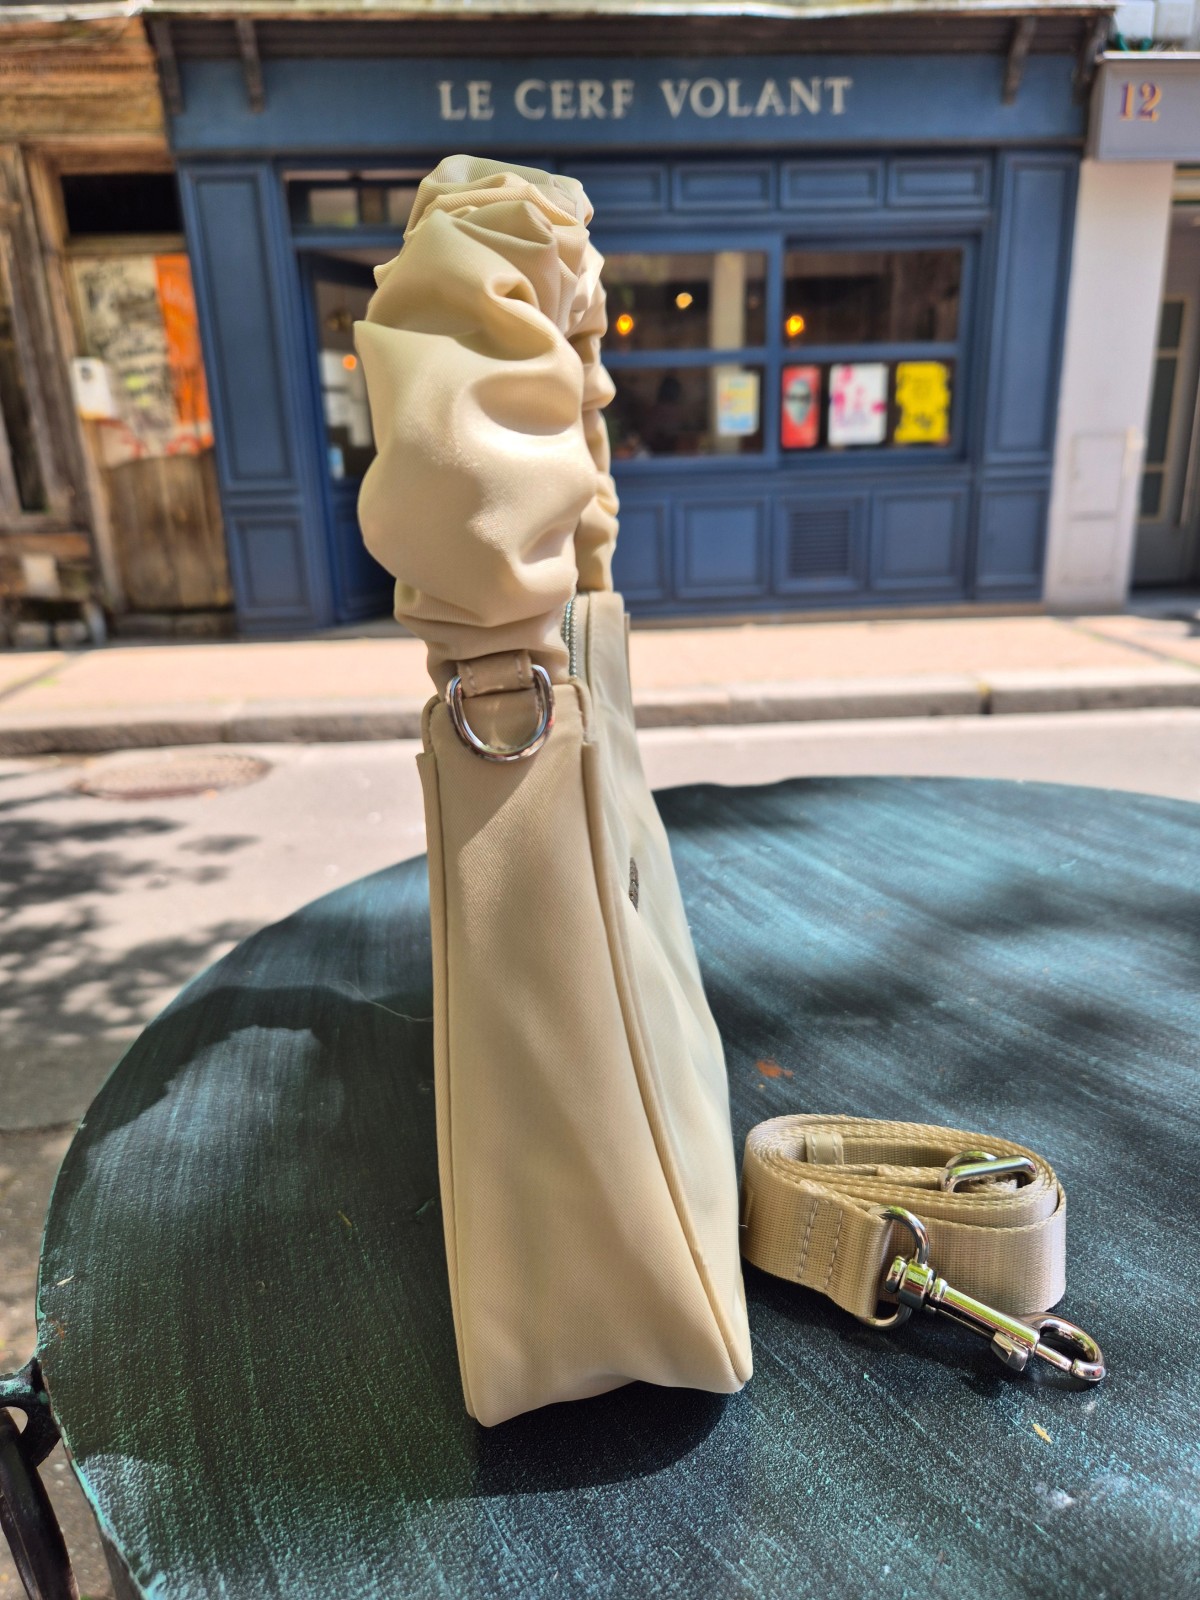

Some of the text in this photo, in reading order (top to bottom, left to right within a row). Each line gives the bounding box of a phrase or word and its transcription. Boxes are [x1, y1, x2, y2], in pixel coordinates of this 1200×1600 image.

[438, 76, 853, 121] LE CERF VOLANT
[1119, 81, 1162, 122] 12
